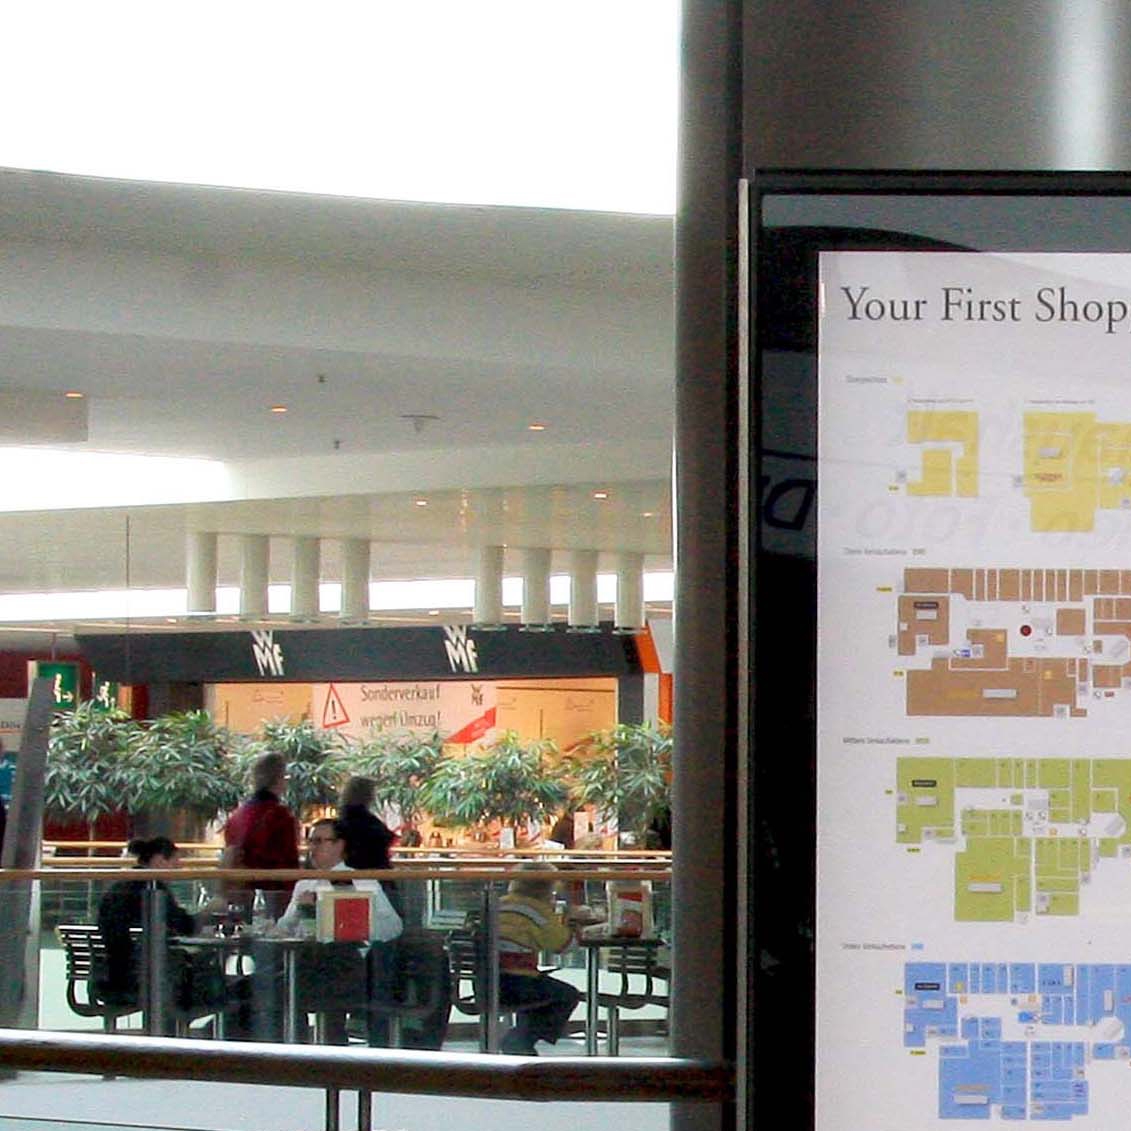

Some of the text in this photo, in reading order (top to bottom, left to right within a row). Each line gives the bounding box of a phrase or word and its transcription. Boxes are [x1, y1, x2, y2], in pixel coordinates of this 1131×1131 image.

[841, 285, 928, 323] Your
[940, 285, 1022, 323] First
[251, 630, 286, 677] WMF
[443, 625, 479, 674] WMF
[361, 684, 441, 703] Sonderverkauf
